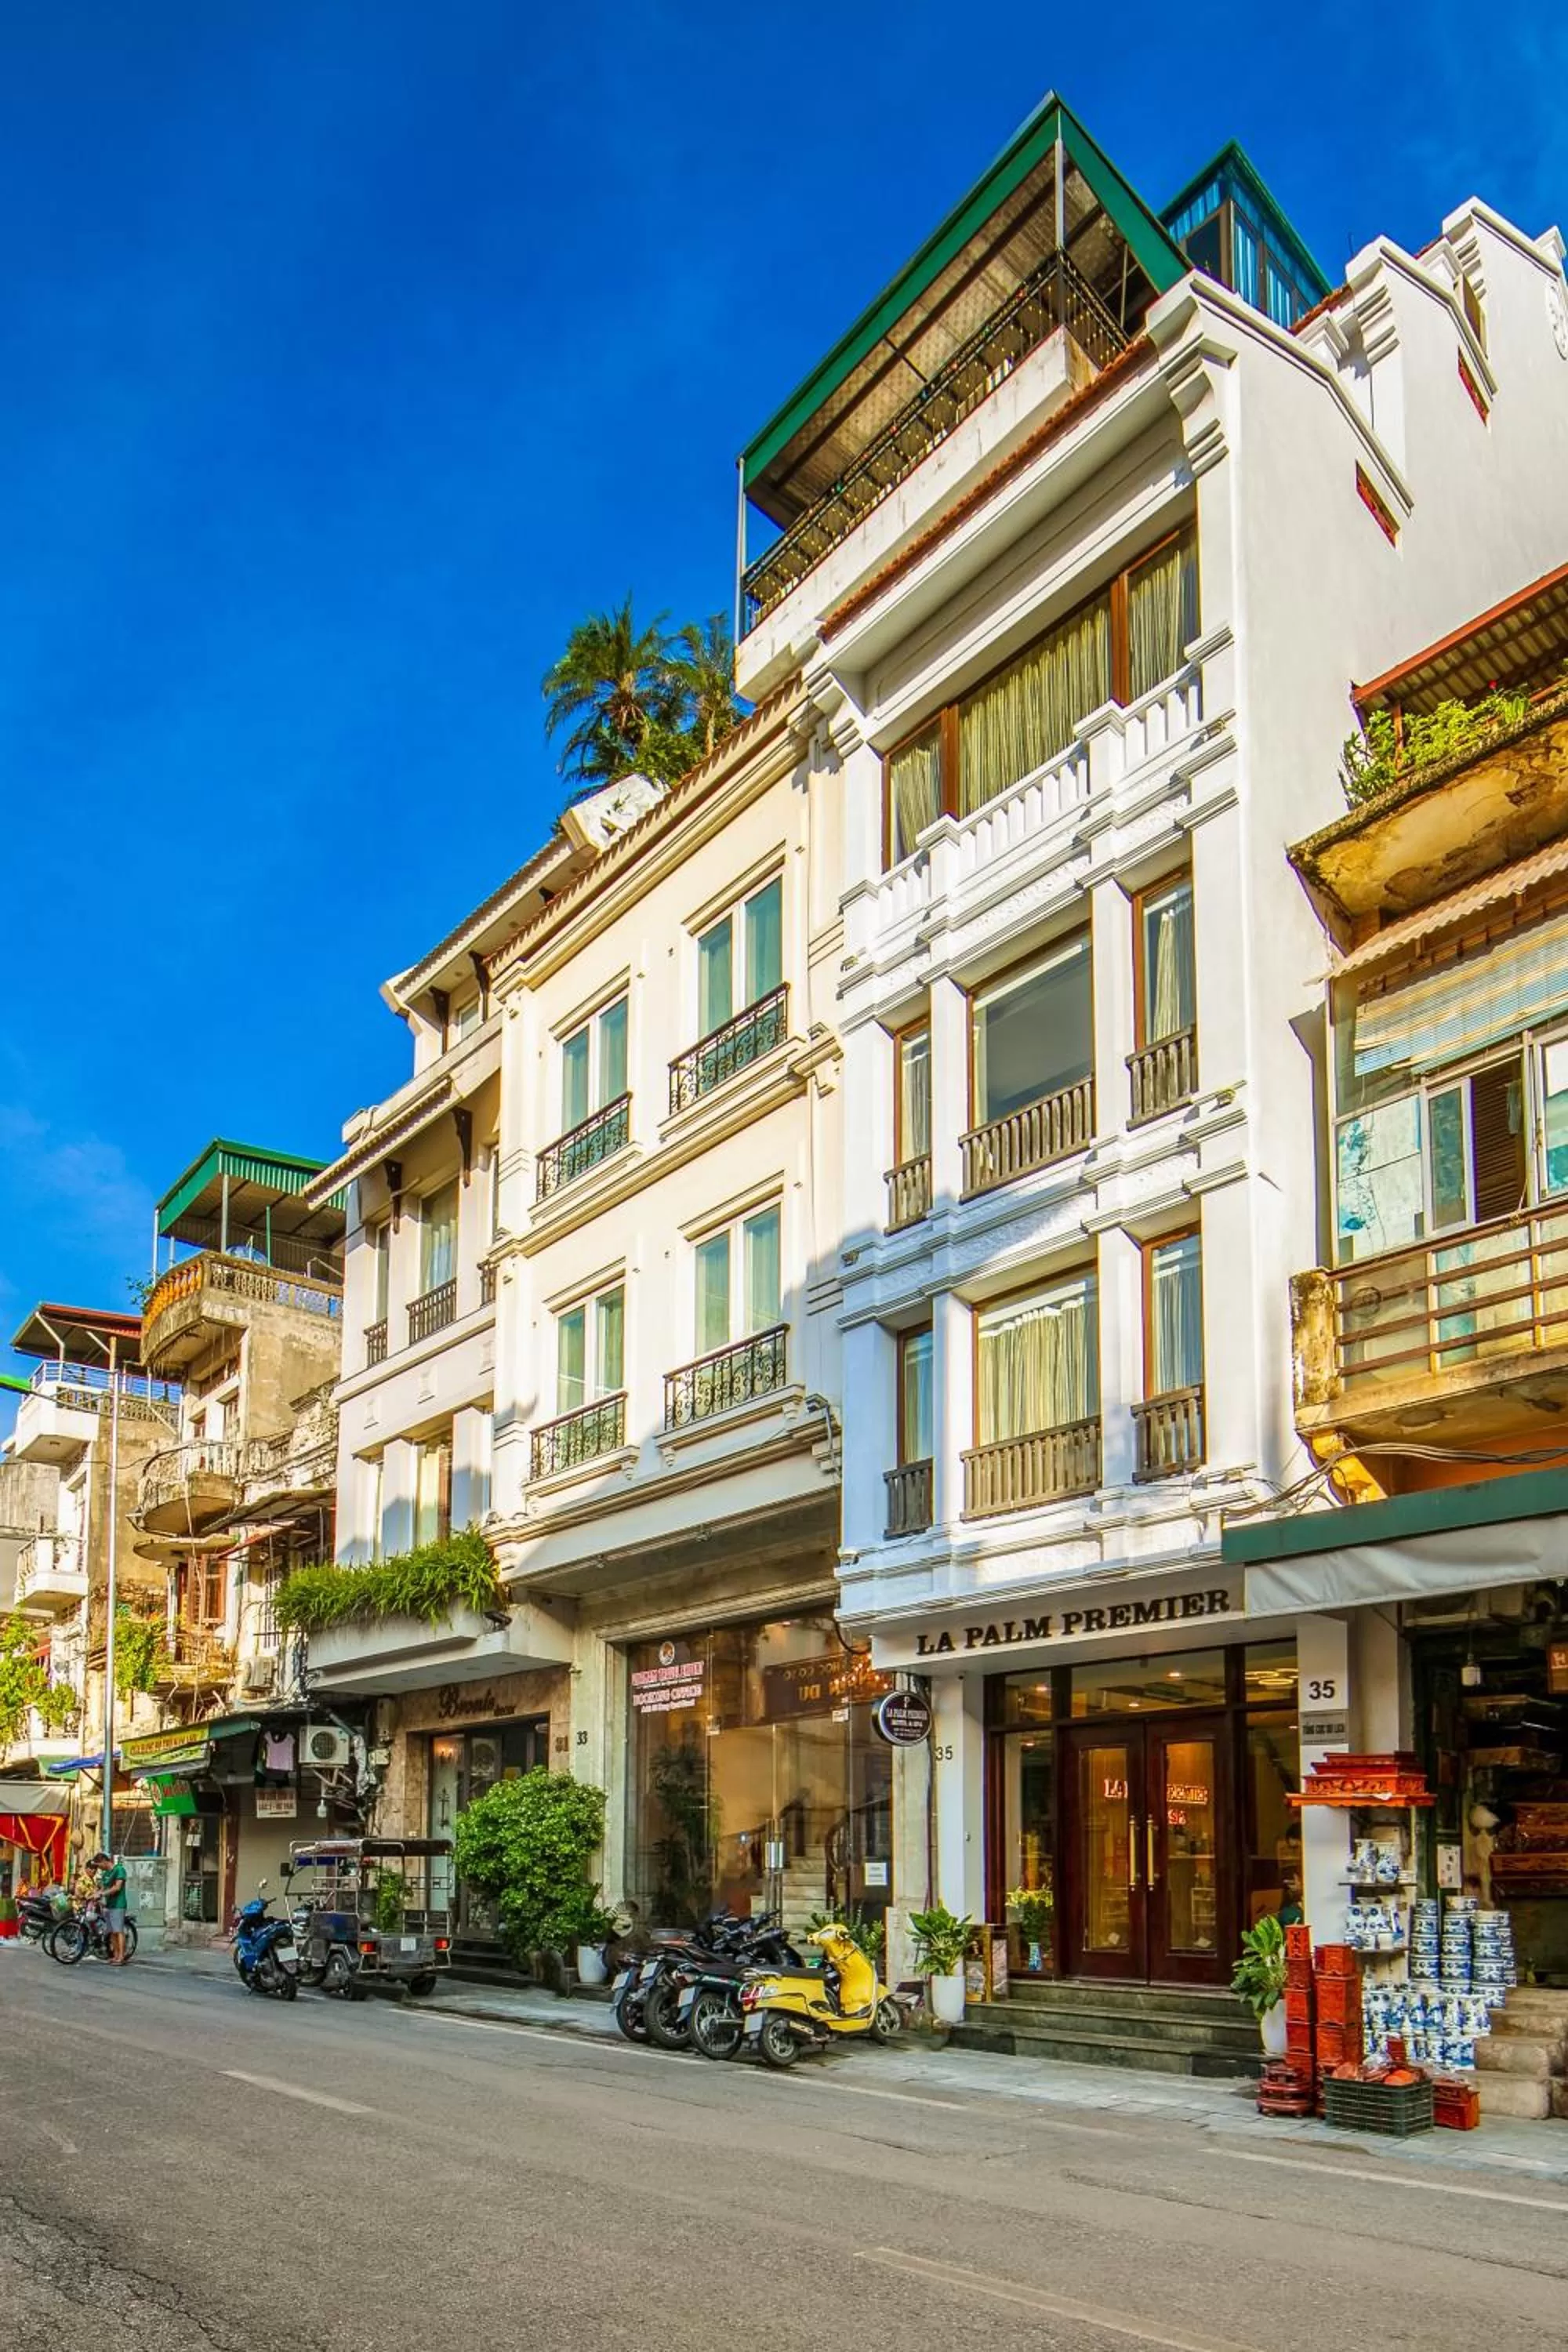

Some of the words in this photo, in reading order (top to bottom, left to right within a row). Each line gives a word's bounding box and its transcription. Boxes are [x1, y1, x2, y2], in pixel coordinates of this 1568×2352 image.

[916, 1634, 956, 1657] LA
[964, 1616, 1052, 1650] PALM
[1061, 1590, 1231, 1636] PREMIER
[1308, 1679, 1335, 1700] 35
[576, 1730, 588, 1746] 33
[934, 1745, 953, 1762] 35
